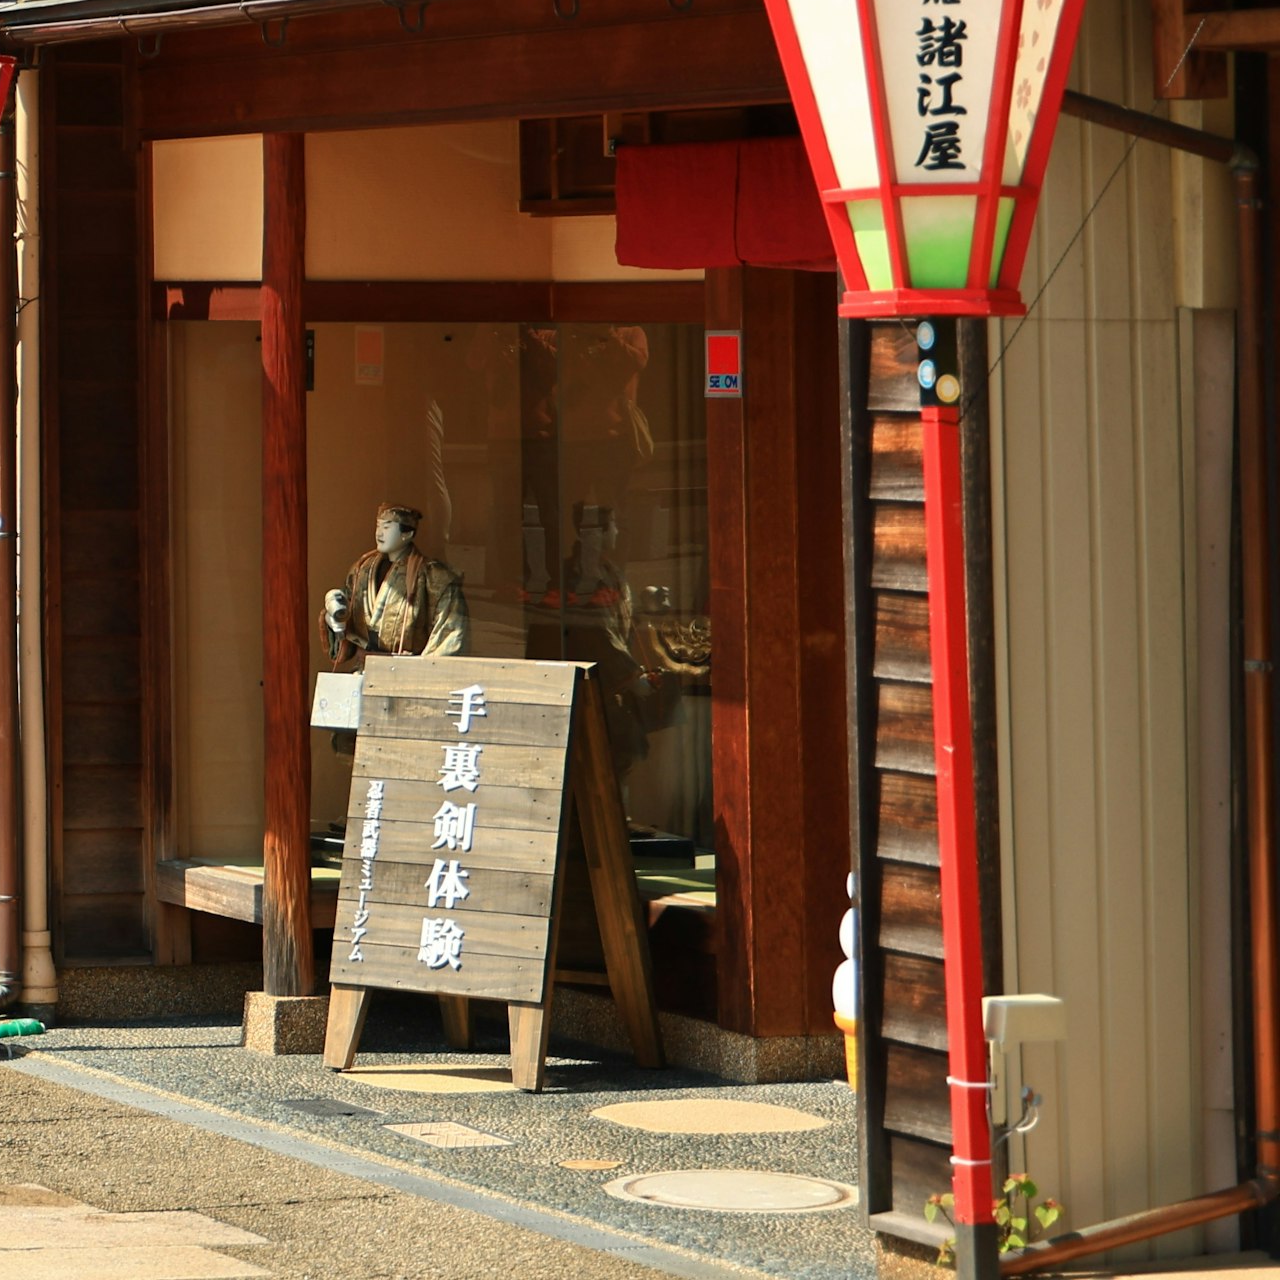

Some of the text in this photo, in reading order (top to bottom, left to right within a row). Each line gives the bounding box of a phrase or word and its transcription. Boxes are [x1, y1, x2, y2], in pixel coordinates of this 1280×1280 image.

[348, 780, 385, 963] 忍者武器ミュージアム
[417, 683, 487, 971] 手裏剣体験
